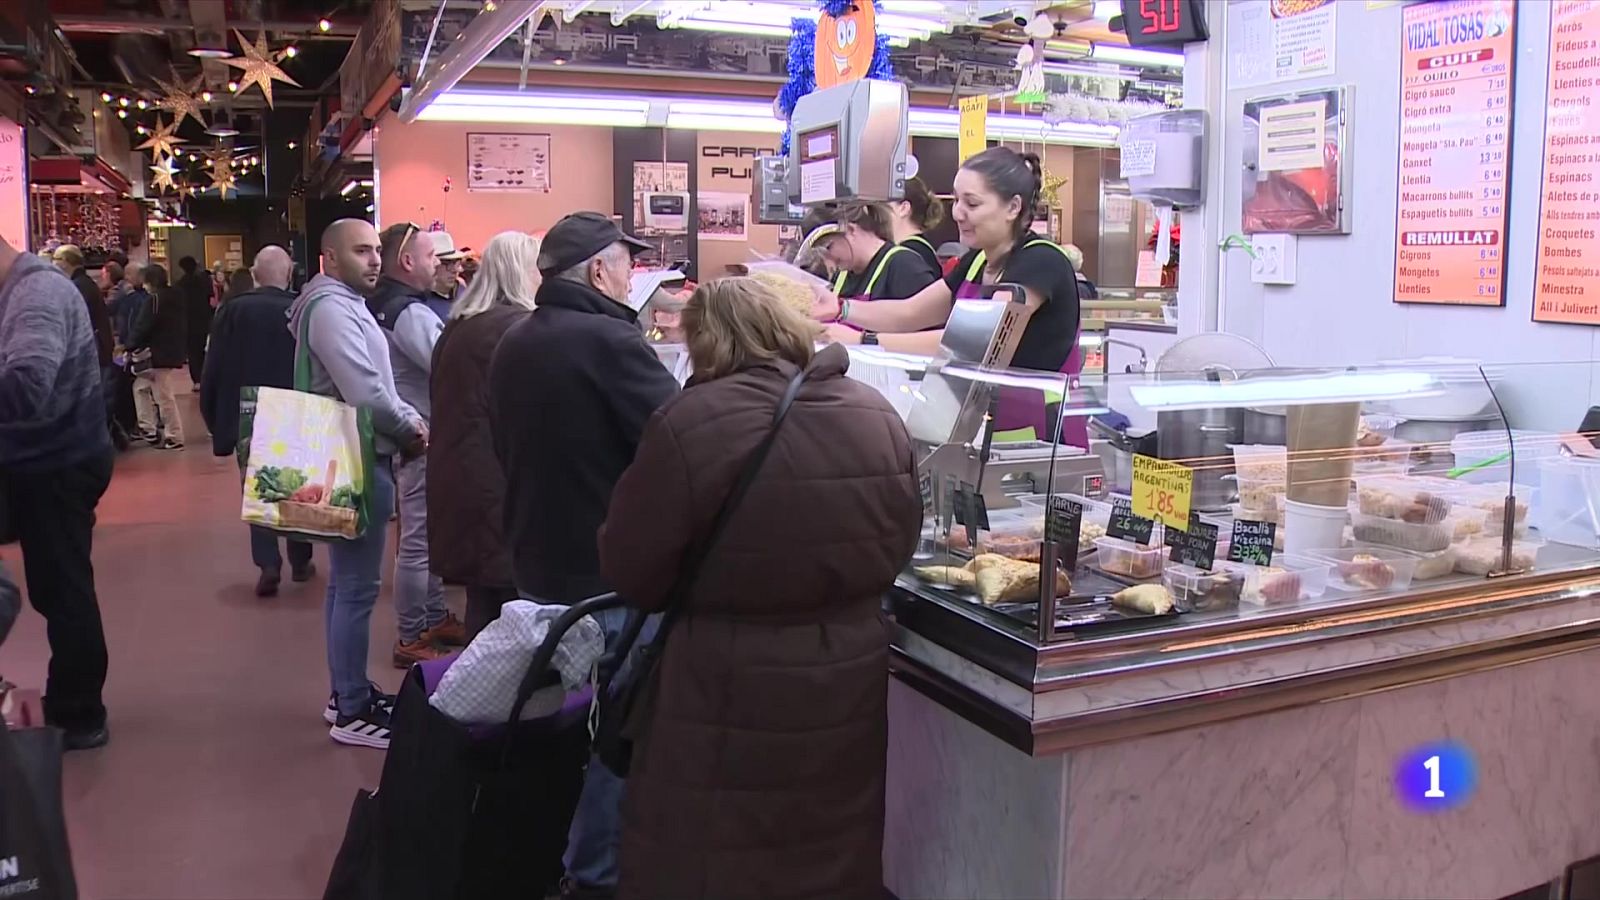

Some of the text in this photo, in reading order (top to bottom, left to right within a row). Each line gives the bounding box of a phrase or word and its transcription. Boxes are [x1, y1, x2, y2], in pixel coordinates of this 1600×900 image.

[1140, 0, 1179, 33] 50
[1407, 11, 1484, 51] VIDAL TOSAS
[1556, 40, 1597, 52] Fideus a
[1429, 50, 1482, 68] CUIT
[1554, 77, 1593, 90] Llenties
[1405, 88, 1427, 102] Cigró
[1404, 106, 1427, 118] Cigró
[1429, 104, 1452, 115] extra
[1404, 122, 1441, 135] Mongeta
[1403, 139, 1438, 152] Mongeta
[1551, 133, 1589, 147] Espinacs
[703, 146, 775, 158] CARN
[1402, 157, 1432, 168] Ganxet
[1550, 153, 1587, 166] Espinacs
[1588, 154, 1594, 163] a
[712, 167, 751, 179] PUI
[1402, 173, 1431, 185] Llentia
[1548, 172, 1593, 185] Espinacs
[1401, 191, 1447, 202] Macarrons
[1449, 189, 1474, 200] bullits
[1547, 191, 1578, 201] Aletes
[1580, 190, 1591, 201] de
[1401, 208, 1447, 220] Espaguetis
[1449, 207, 1474, 218] bullits
[1406, 230, 1494, 245] REMULLAT
[1545, 228, 1595, 240] Croquetes
[1400, 249, 1431, 261] Cigrons
[1544, 246, 1582, 258] Bombes
[1399, 267, 1440, 278] Mongetes
[1398, 282, 1431, 294] Llenties
[1541, 283, 1584, 295] Minestra
[1540, 301, 1553, 313] All
[1560, 301, 1598, 315] Julivert
